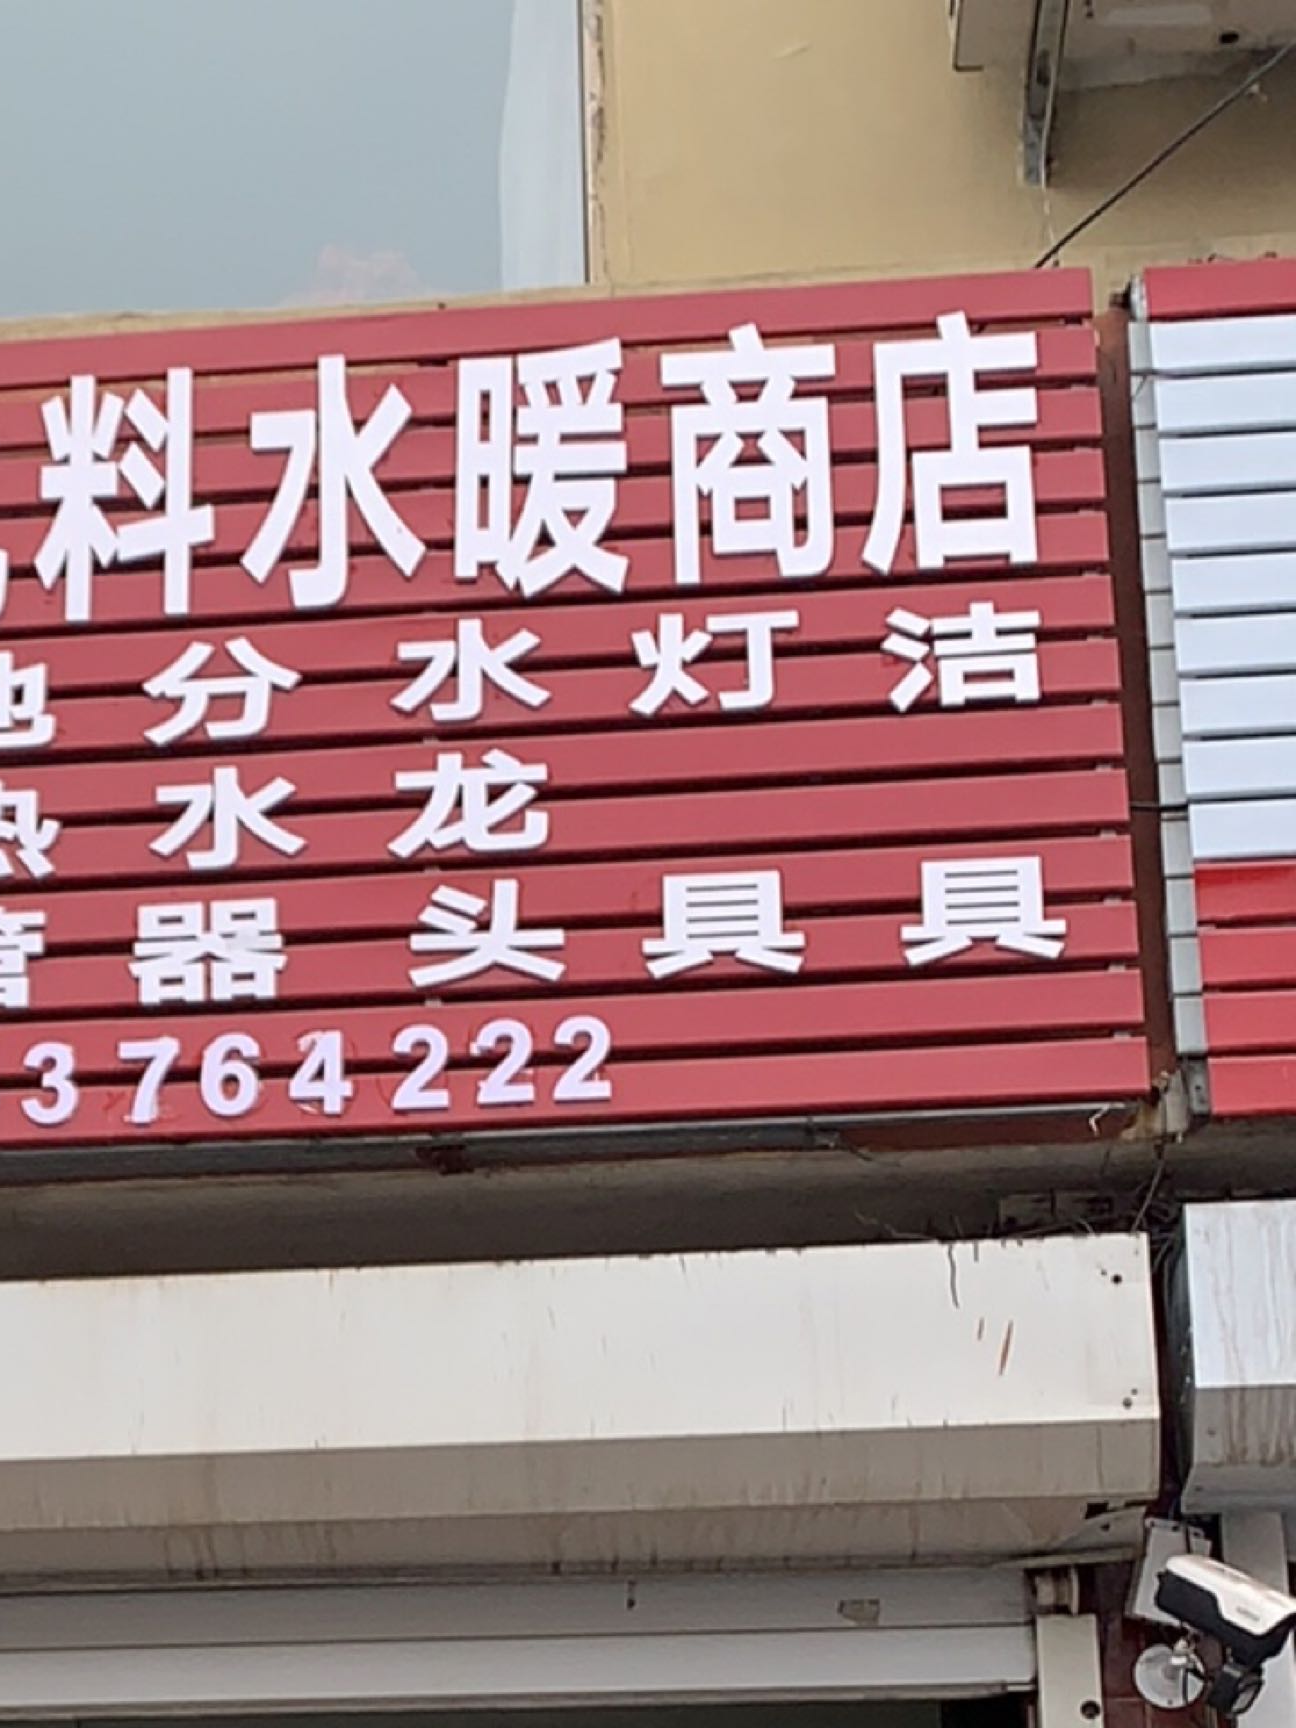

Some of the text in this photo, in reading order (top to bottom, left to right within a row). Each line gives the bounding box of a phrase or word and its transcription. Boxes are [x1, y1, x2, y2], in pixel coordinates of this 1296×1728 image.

[129, 637, 306, 1005] 分水器
[389, 618, 565, 988] 水龙头
[630, 610, 805, 979] 灯具
[881, 602, 1067, 967] 洁具
